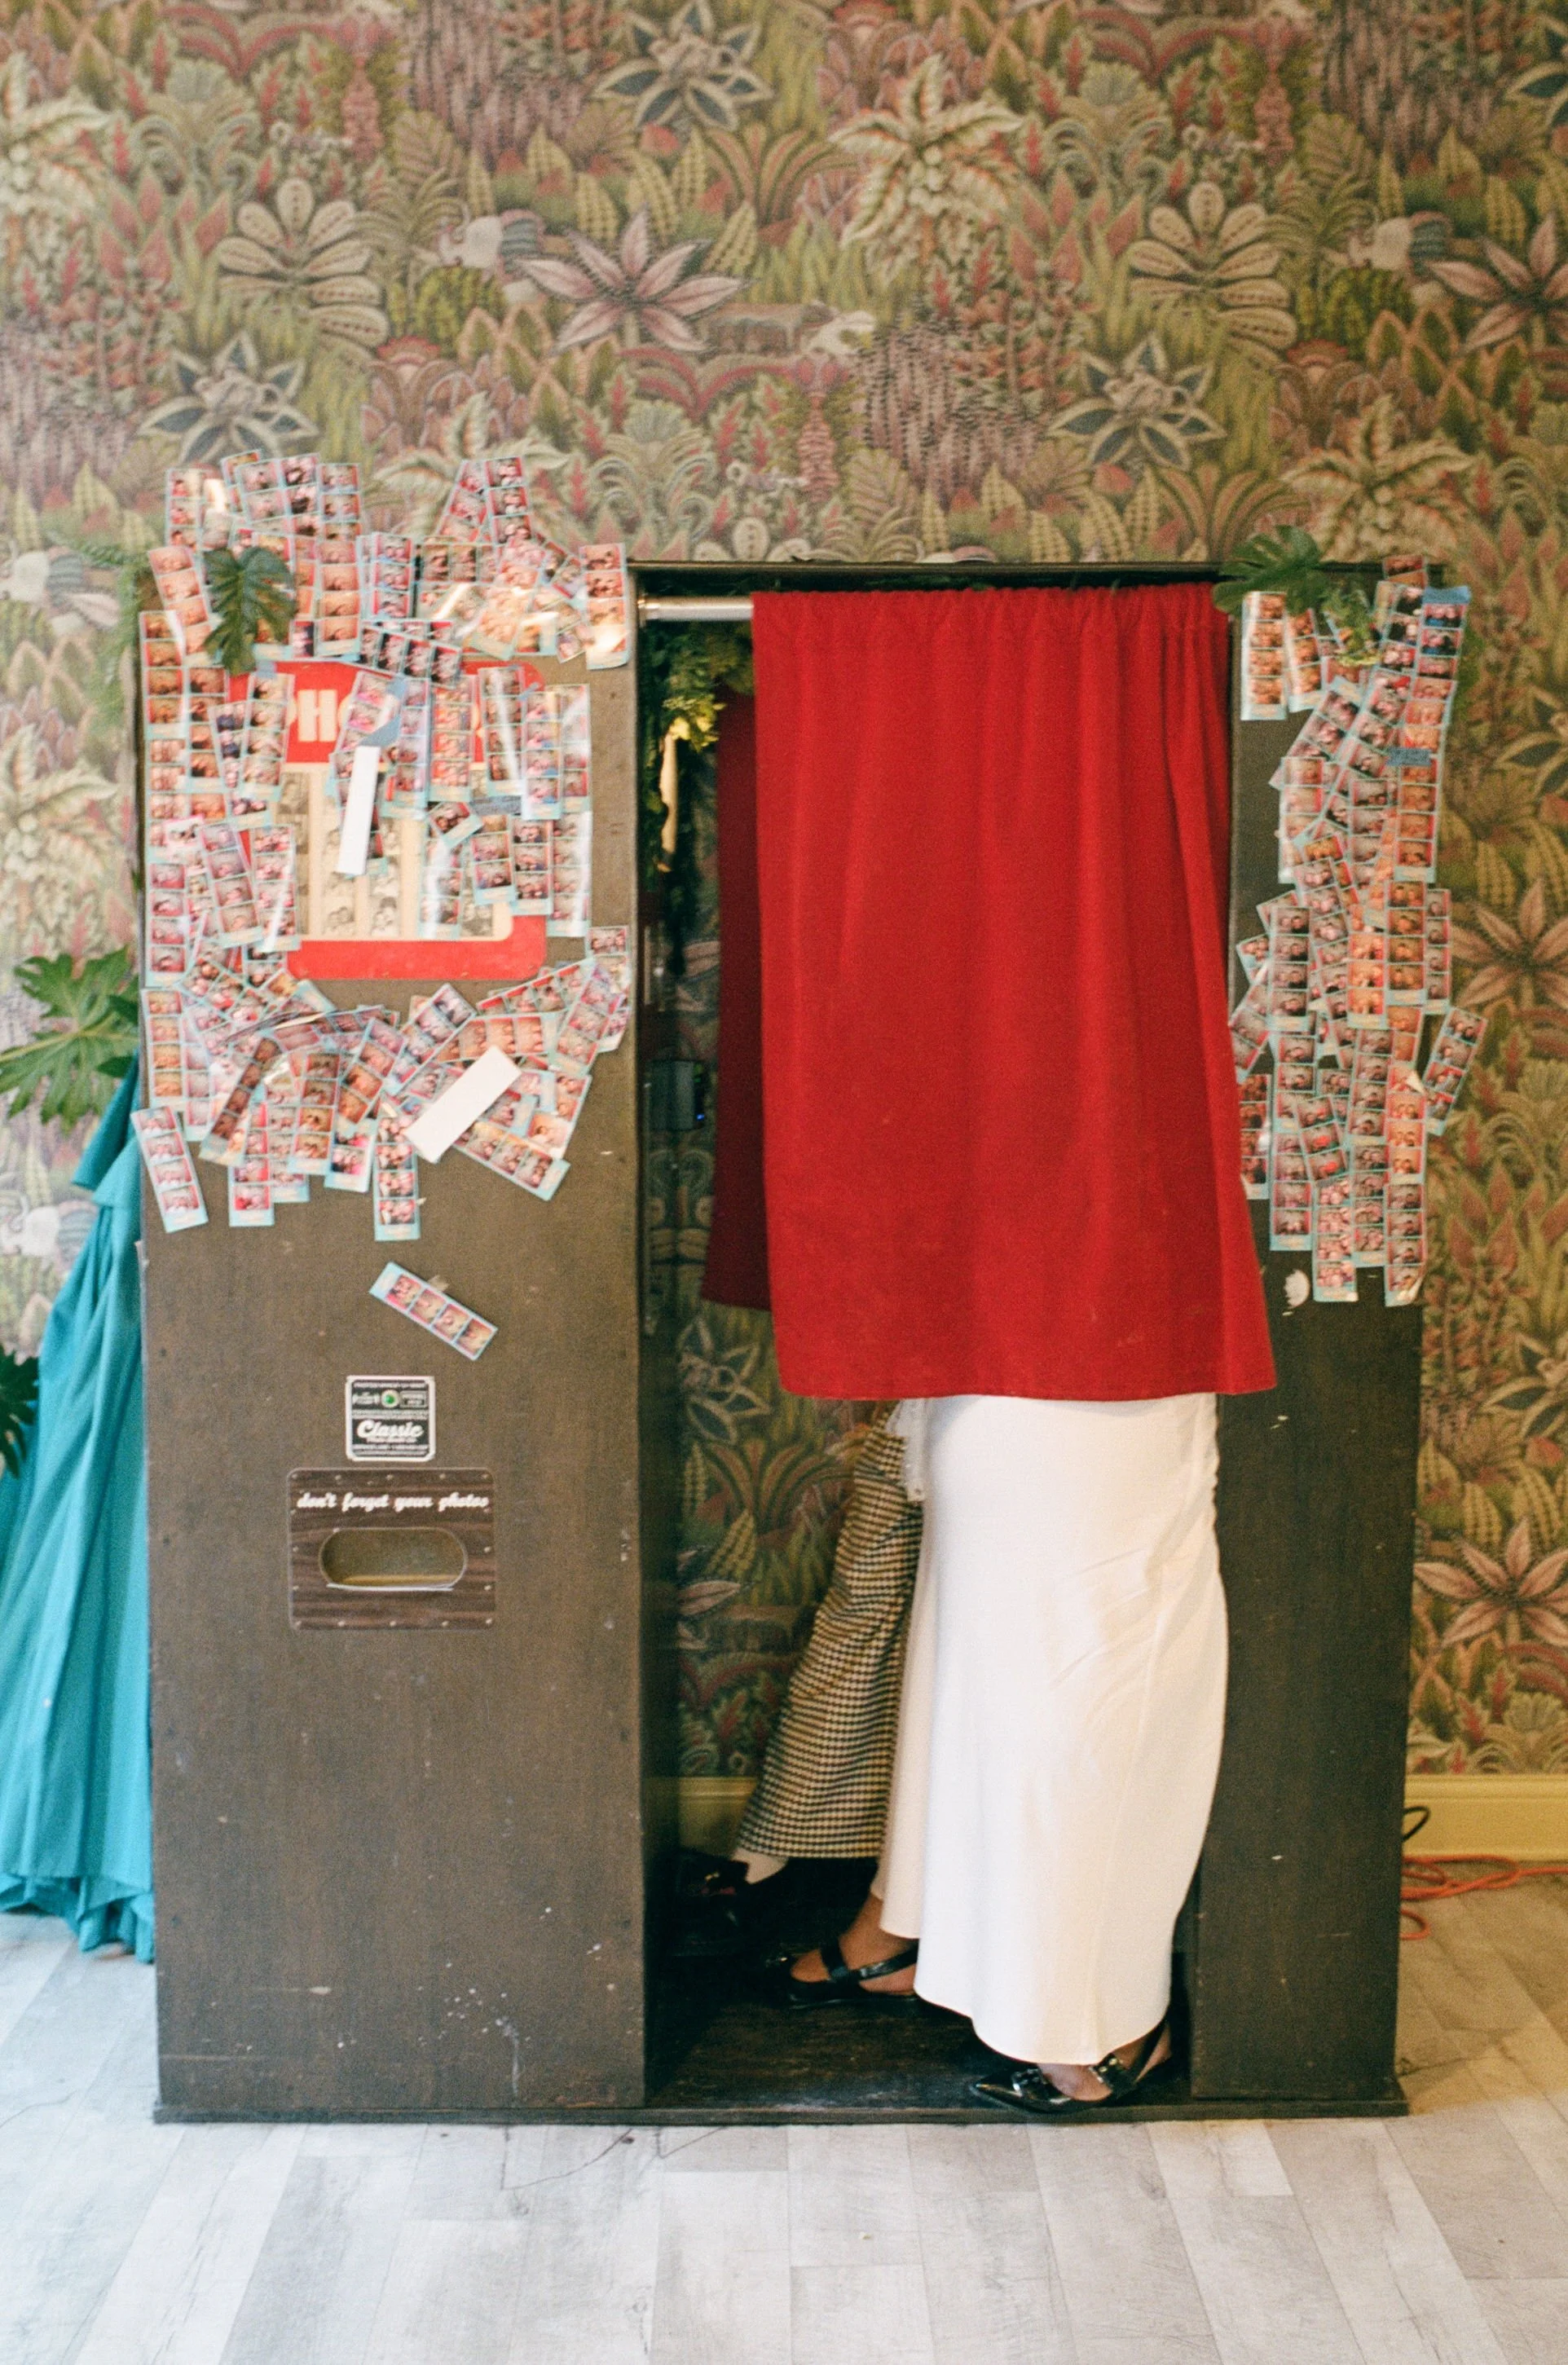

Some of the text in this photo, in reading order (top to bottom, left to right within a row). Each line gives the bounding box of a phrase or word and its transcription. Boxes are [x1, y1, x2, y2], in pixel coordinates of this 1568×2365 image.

[356, 1420, 424, 1438] Classic
[297, 1491, 489, 1513] don't forget your photos
